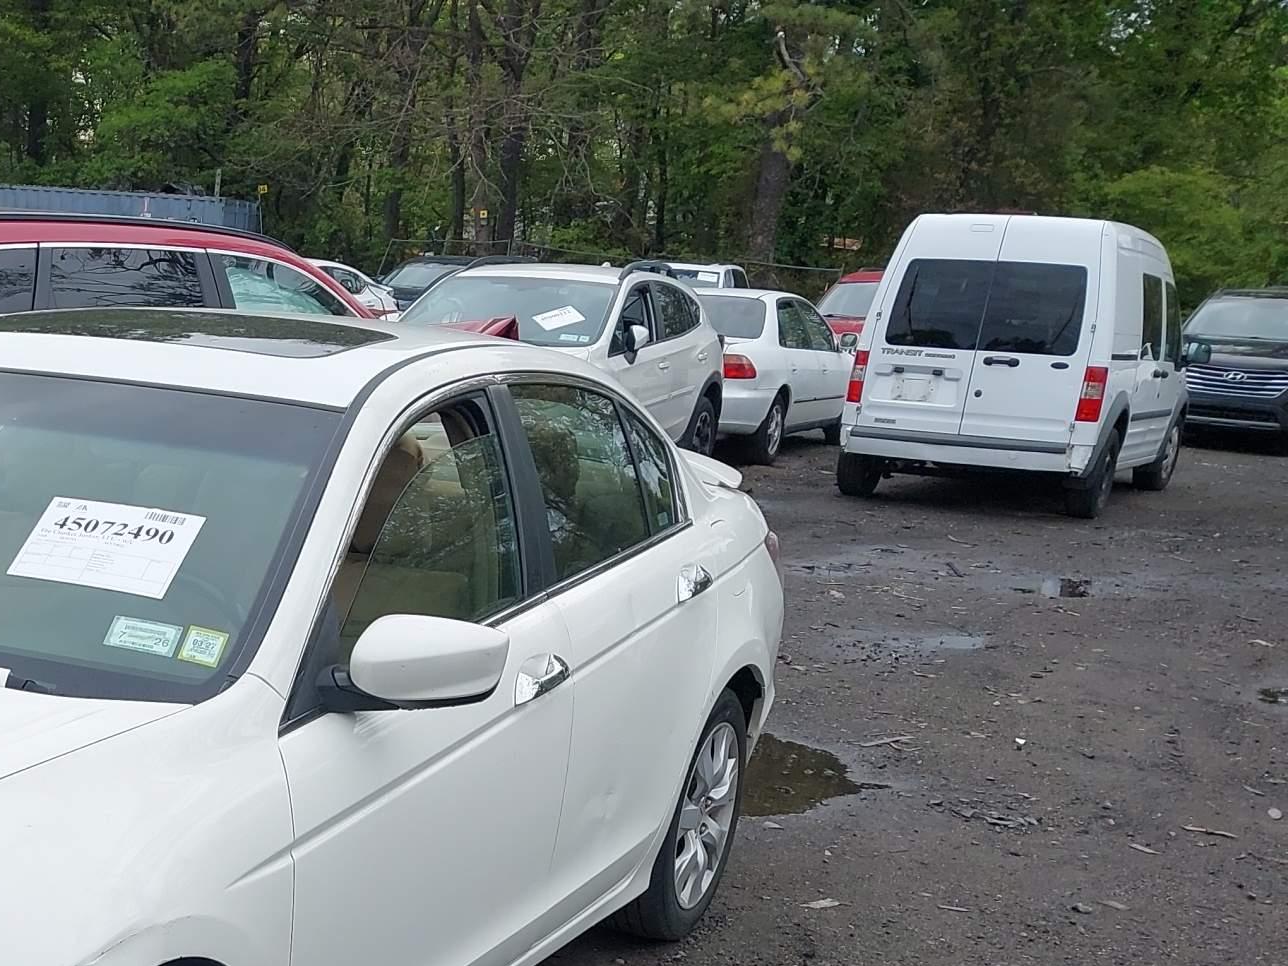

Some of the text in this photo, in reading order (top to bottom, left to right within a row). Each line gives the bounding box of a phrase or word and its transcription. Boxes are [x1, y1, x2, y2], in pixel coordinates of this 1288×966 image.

[881, 347, 924, 357] TRANSIT
[53, 515, 175, 545] 45072490
[153, 637, 170, 648] 26
